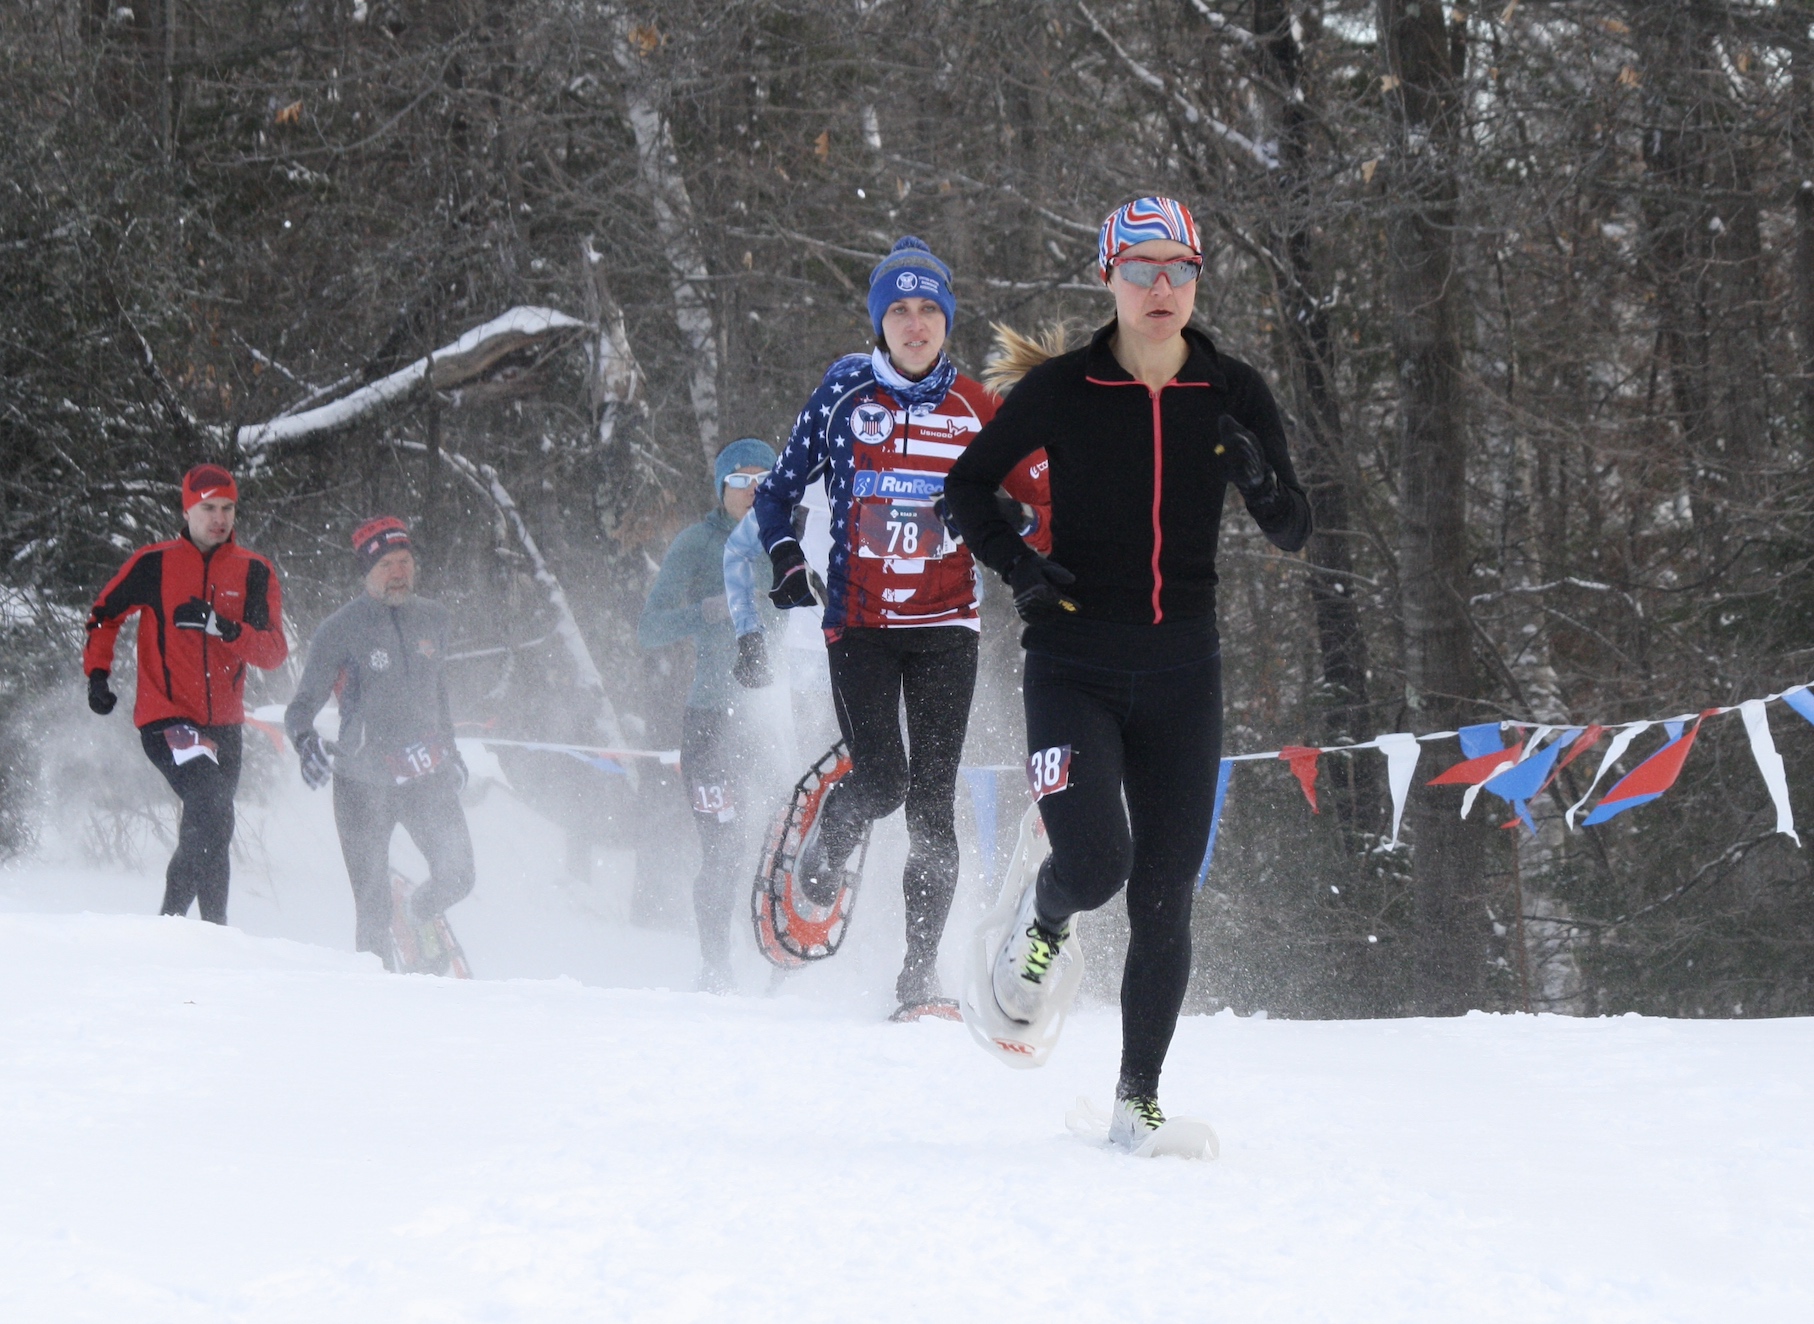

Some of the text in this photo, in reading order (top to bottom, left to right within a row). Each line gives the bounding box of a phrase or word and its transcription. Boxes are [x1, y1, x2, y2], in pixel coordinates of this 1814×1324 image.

[886, 521, 918, 554] 78
[408, 746, 432, 772] 15
[1031, 746, 1062, 793] 38
[698, 785, 724, 809] 13
